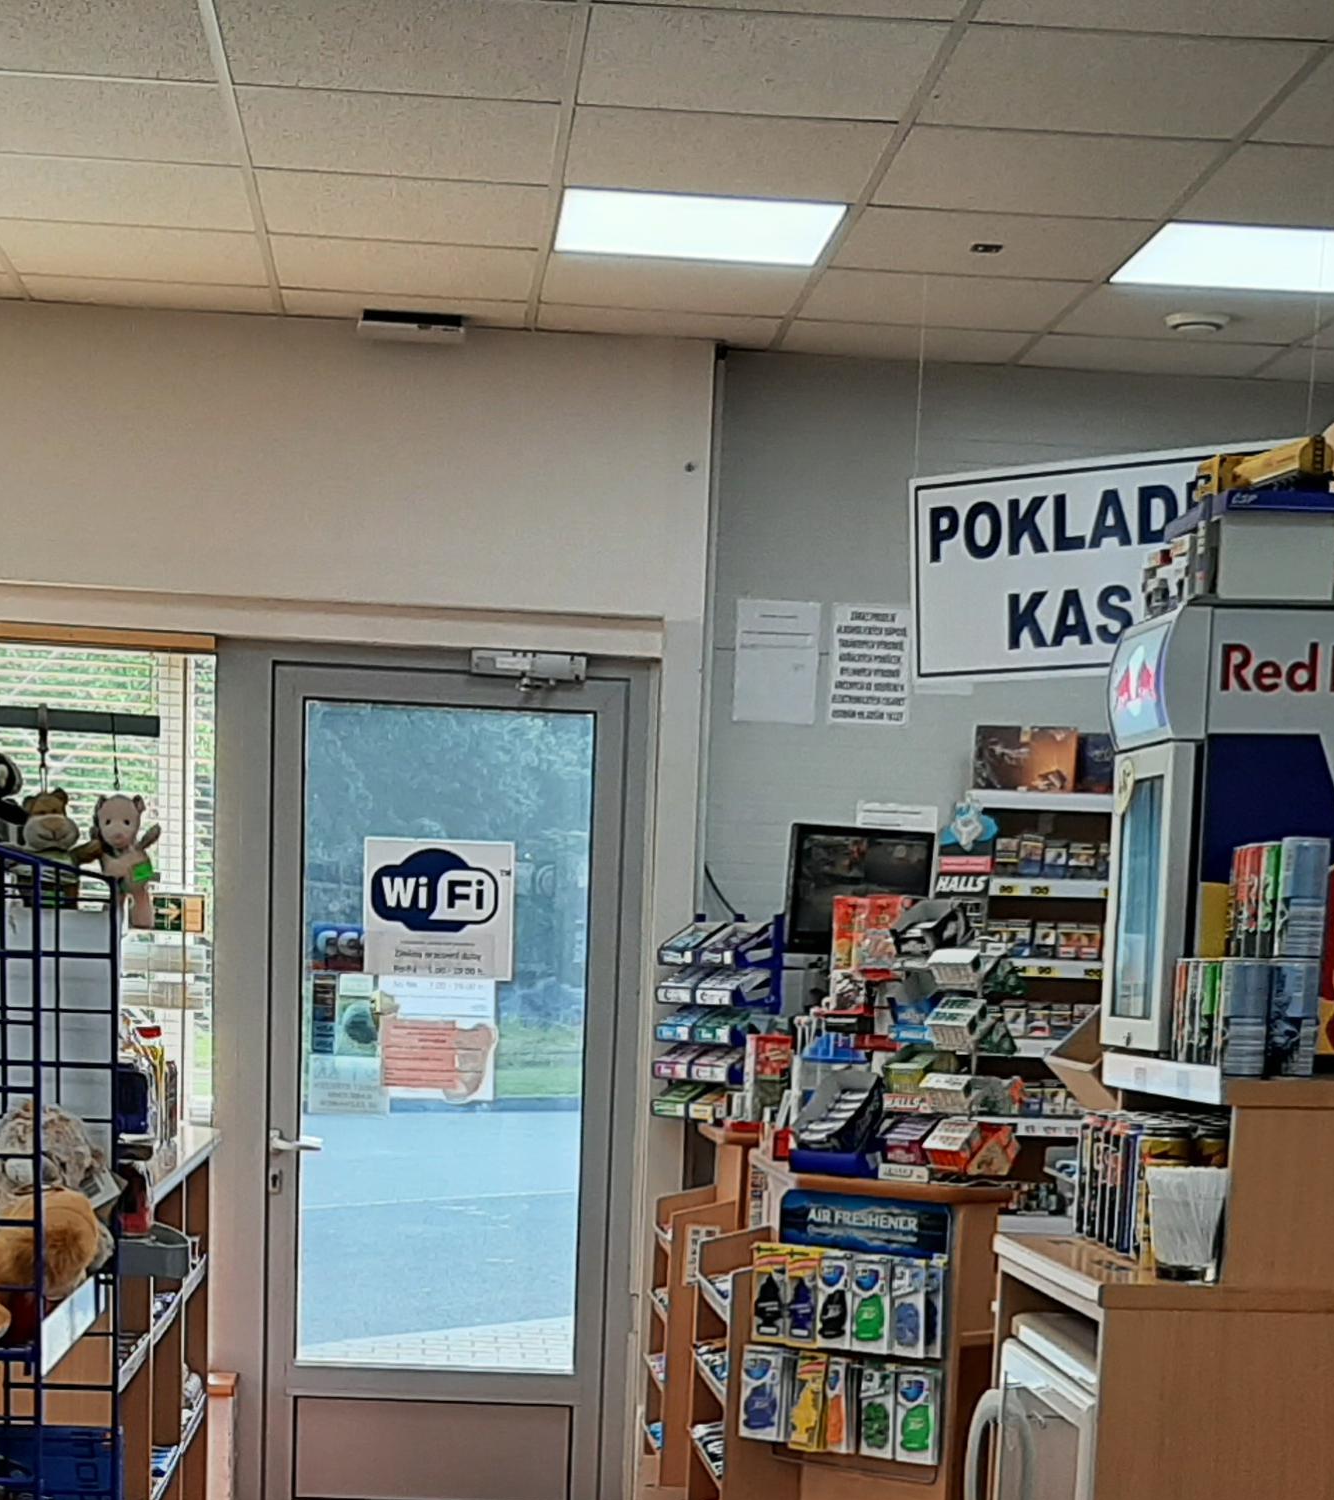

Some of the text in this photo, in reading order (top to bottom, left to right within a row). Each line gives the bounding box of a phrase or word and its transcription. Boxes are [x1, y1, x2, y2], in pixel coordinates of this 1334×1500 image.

[1220, 643, 1319, 693] Red
[936, 874, 989, 893] HALLS
[806, 1207, 919, 1232] AIR FRESHENER
